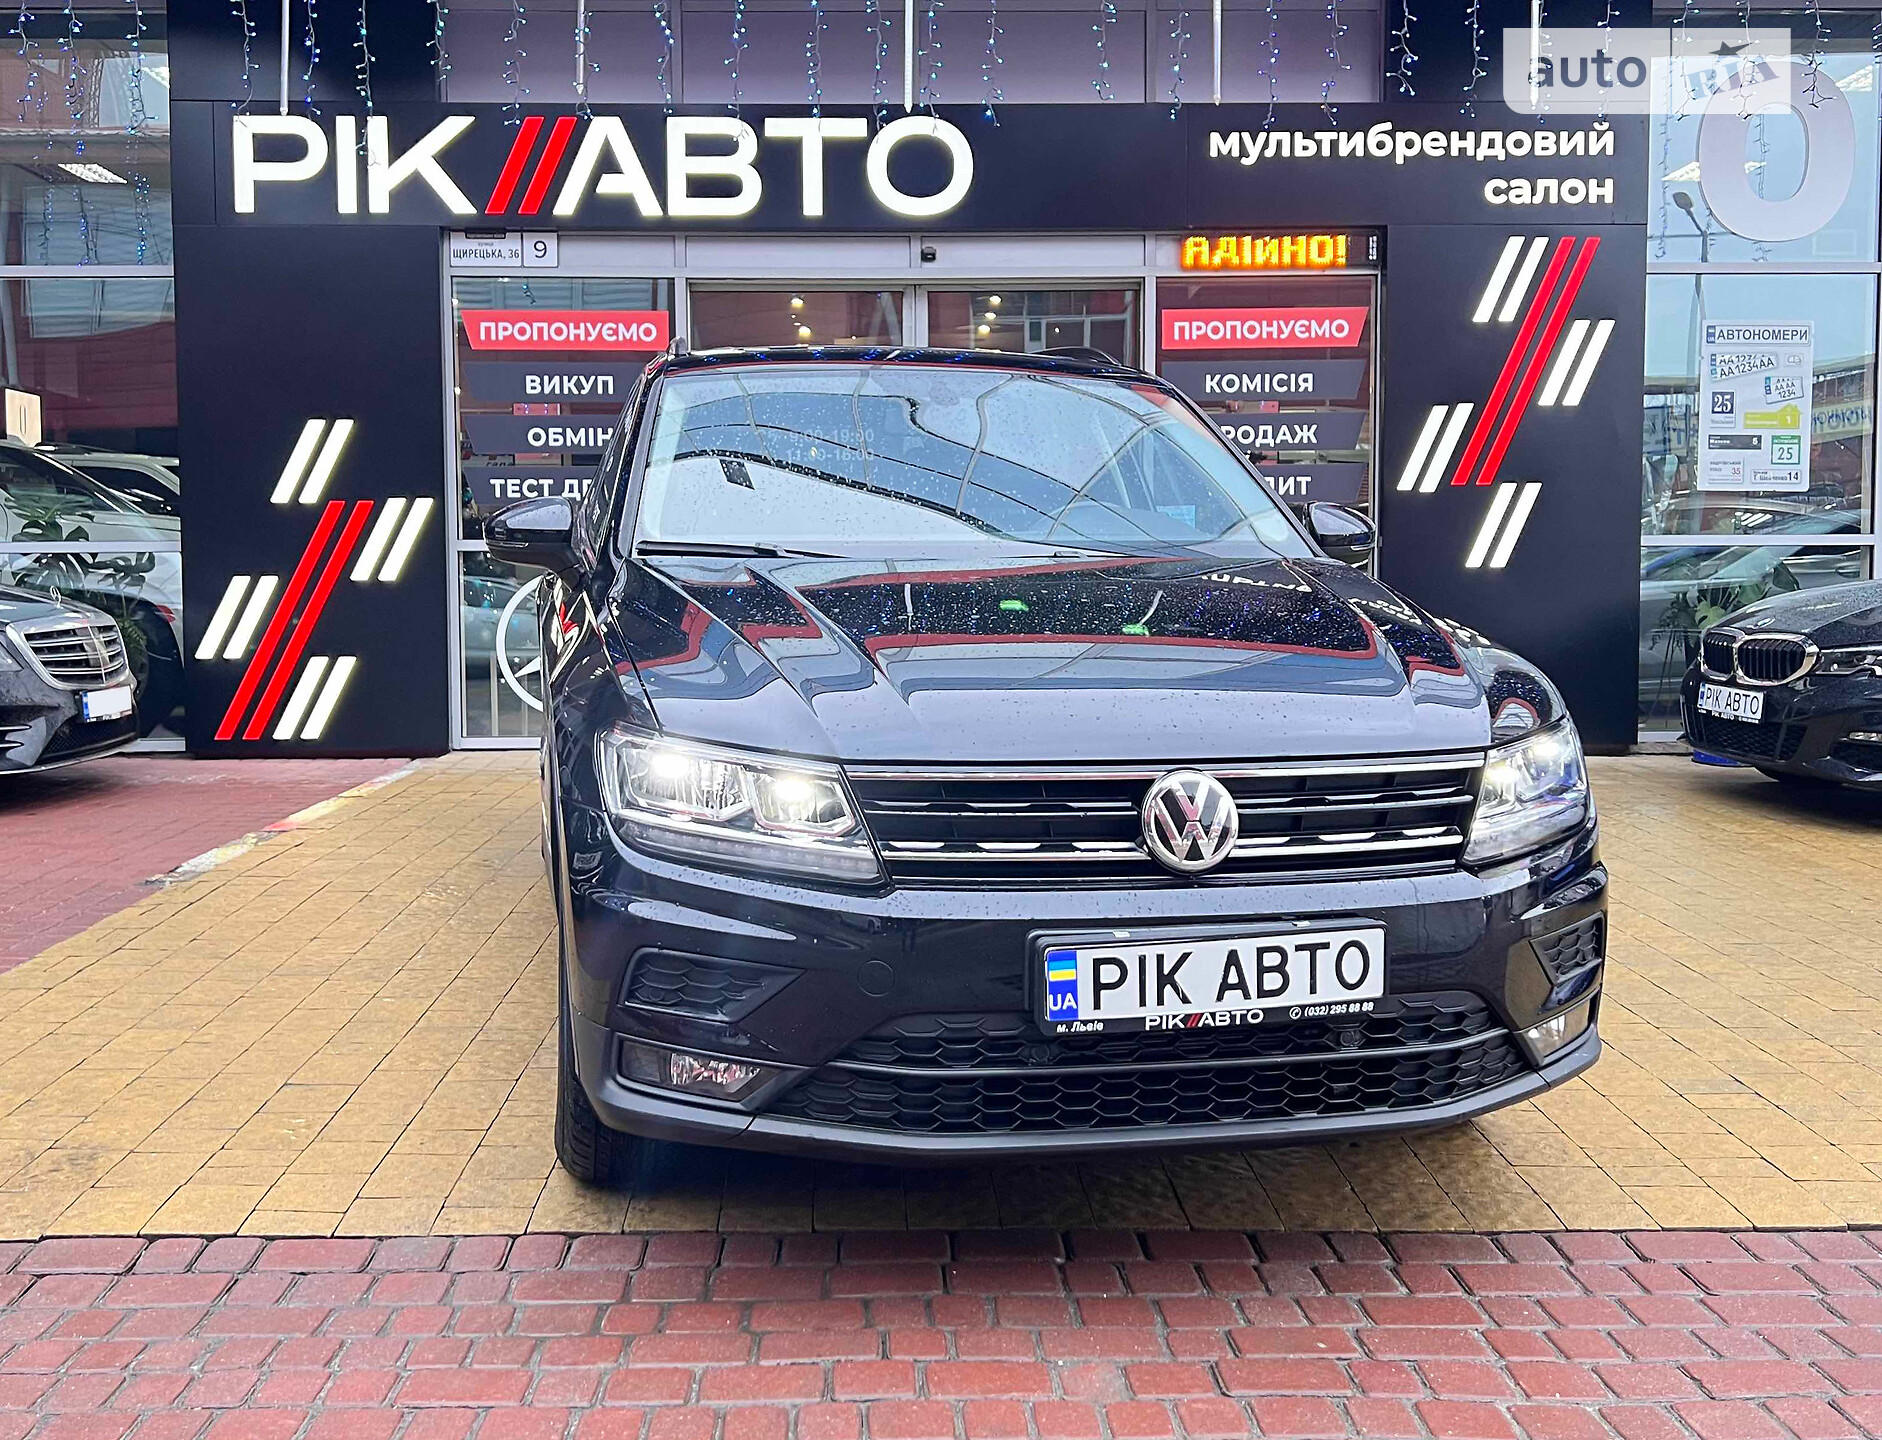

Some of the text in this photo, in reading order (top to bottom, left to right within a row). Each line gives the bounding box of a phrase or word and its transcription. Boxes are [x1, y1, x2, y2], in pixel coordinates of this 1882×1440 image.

[1208, 121, 1615, 165] мультибрендовий
[1484, 177, 1615, 205] салон
[452, 249, 520, 260] ЩИРЕЦЬКА, 36
[533, 240, 547, 259] 9
[479, 322, 657, 341] ПРОПОНУЄМО
[1173, 319, 1349, 341] ПРОПОНУЄМО
[1717, 329, 1808, 341] АВТОНОМЕРИ
[525, 375, 614, 395] ВИКУП
[1205, 373, 1314, 393] КОМІСІЯ
[1713, 394, 1732, 413] 25
[527, 427, 613, 447] ОБМІН
[1777, 447, 1793, 460] 25
[1787, 471, 1799, 481] 14
[489, 479, 553, 498] ТЕСТ
[1725, 691, 1760, 715] АВТО
[1091, 939, 1371, 1011] РІК АВТО
[1049, 993, 1078, 1011] UA
[1304, 1005, 1329, 1017] (032)
[1330, 1004, 1347, 1015] 295
